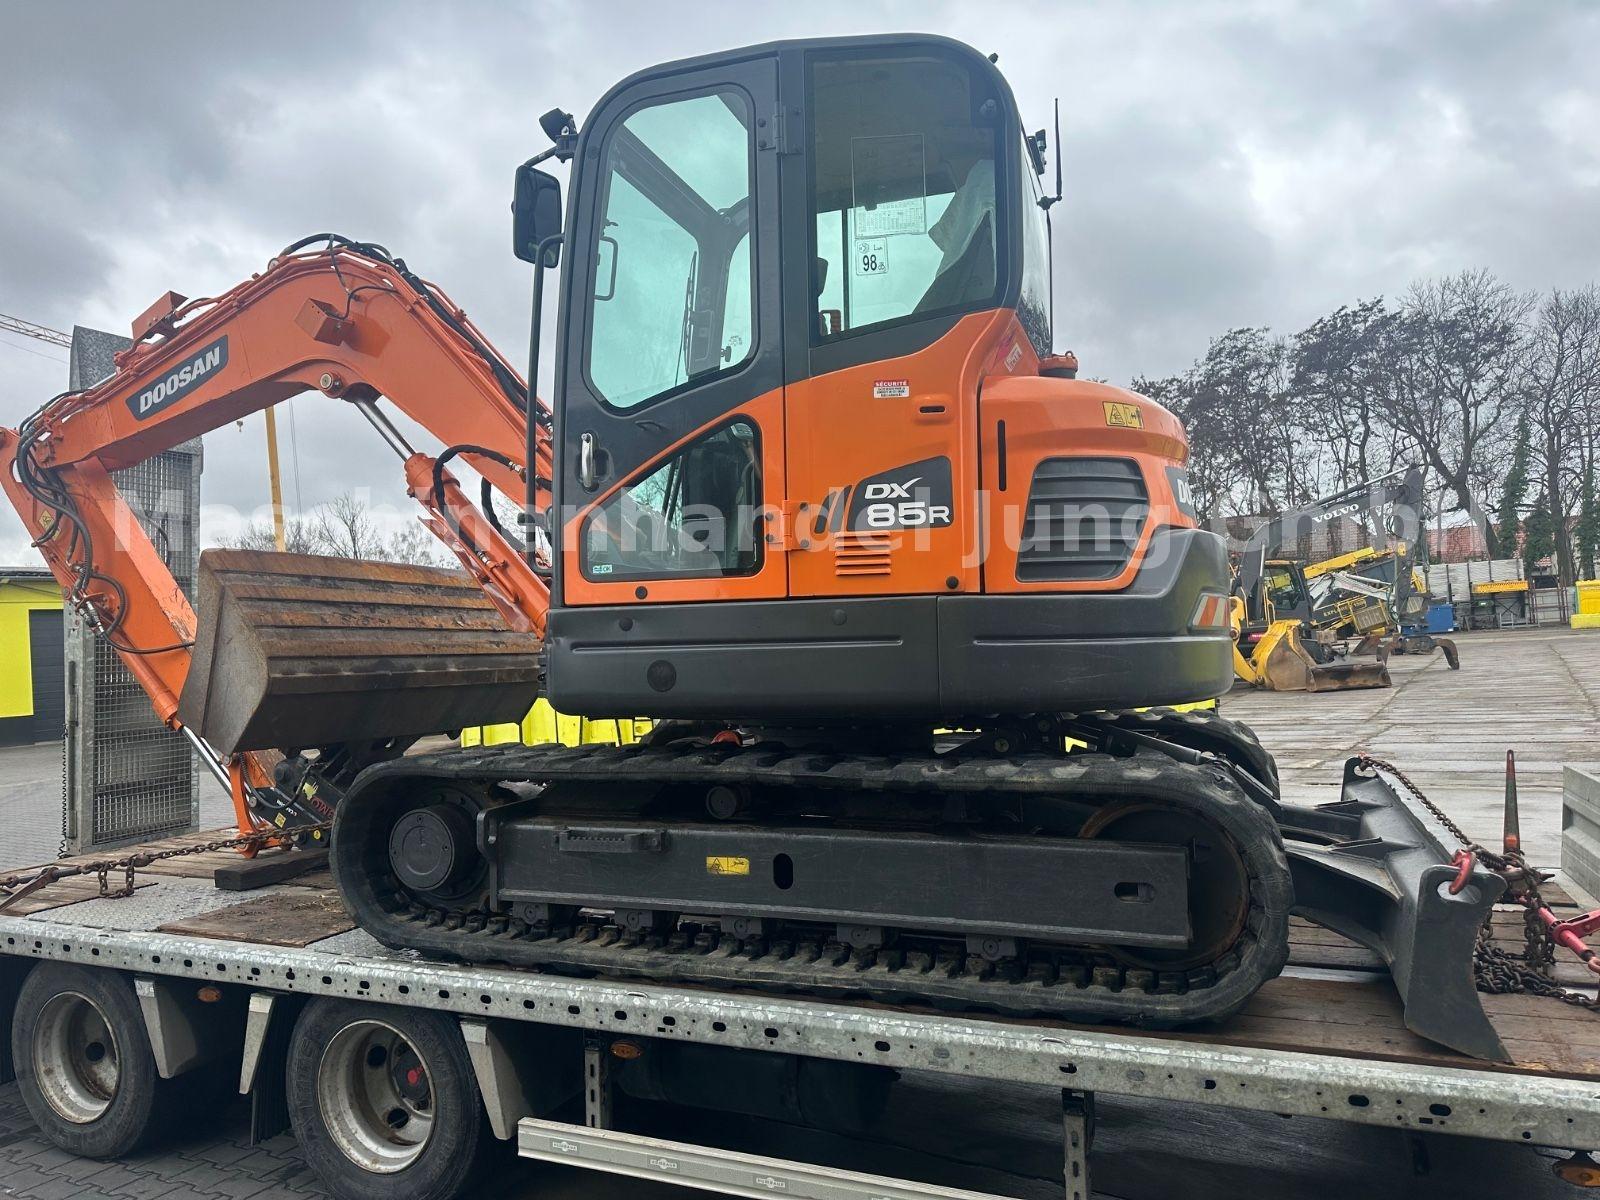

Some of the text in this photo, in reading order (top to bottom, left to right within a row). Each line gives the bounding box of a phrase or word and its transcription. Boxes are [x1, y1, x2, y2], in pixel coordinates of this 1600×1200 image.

[863, 255, 877, 271] 98
[140, 346, 220, 413] DOOSAN
[864, 477, 922, 499] DX
[867, 502, 950, 527] 85R
[1312, 504, 1359, 523] VOLVO
